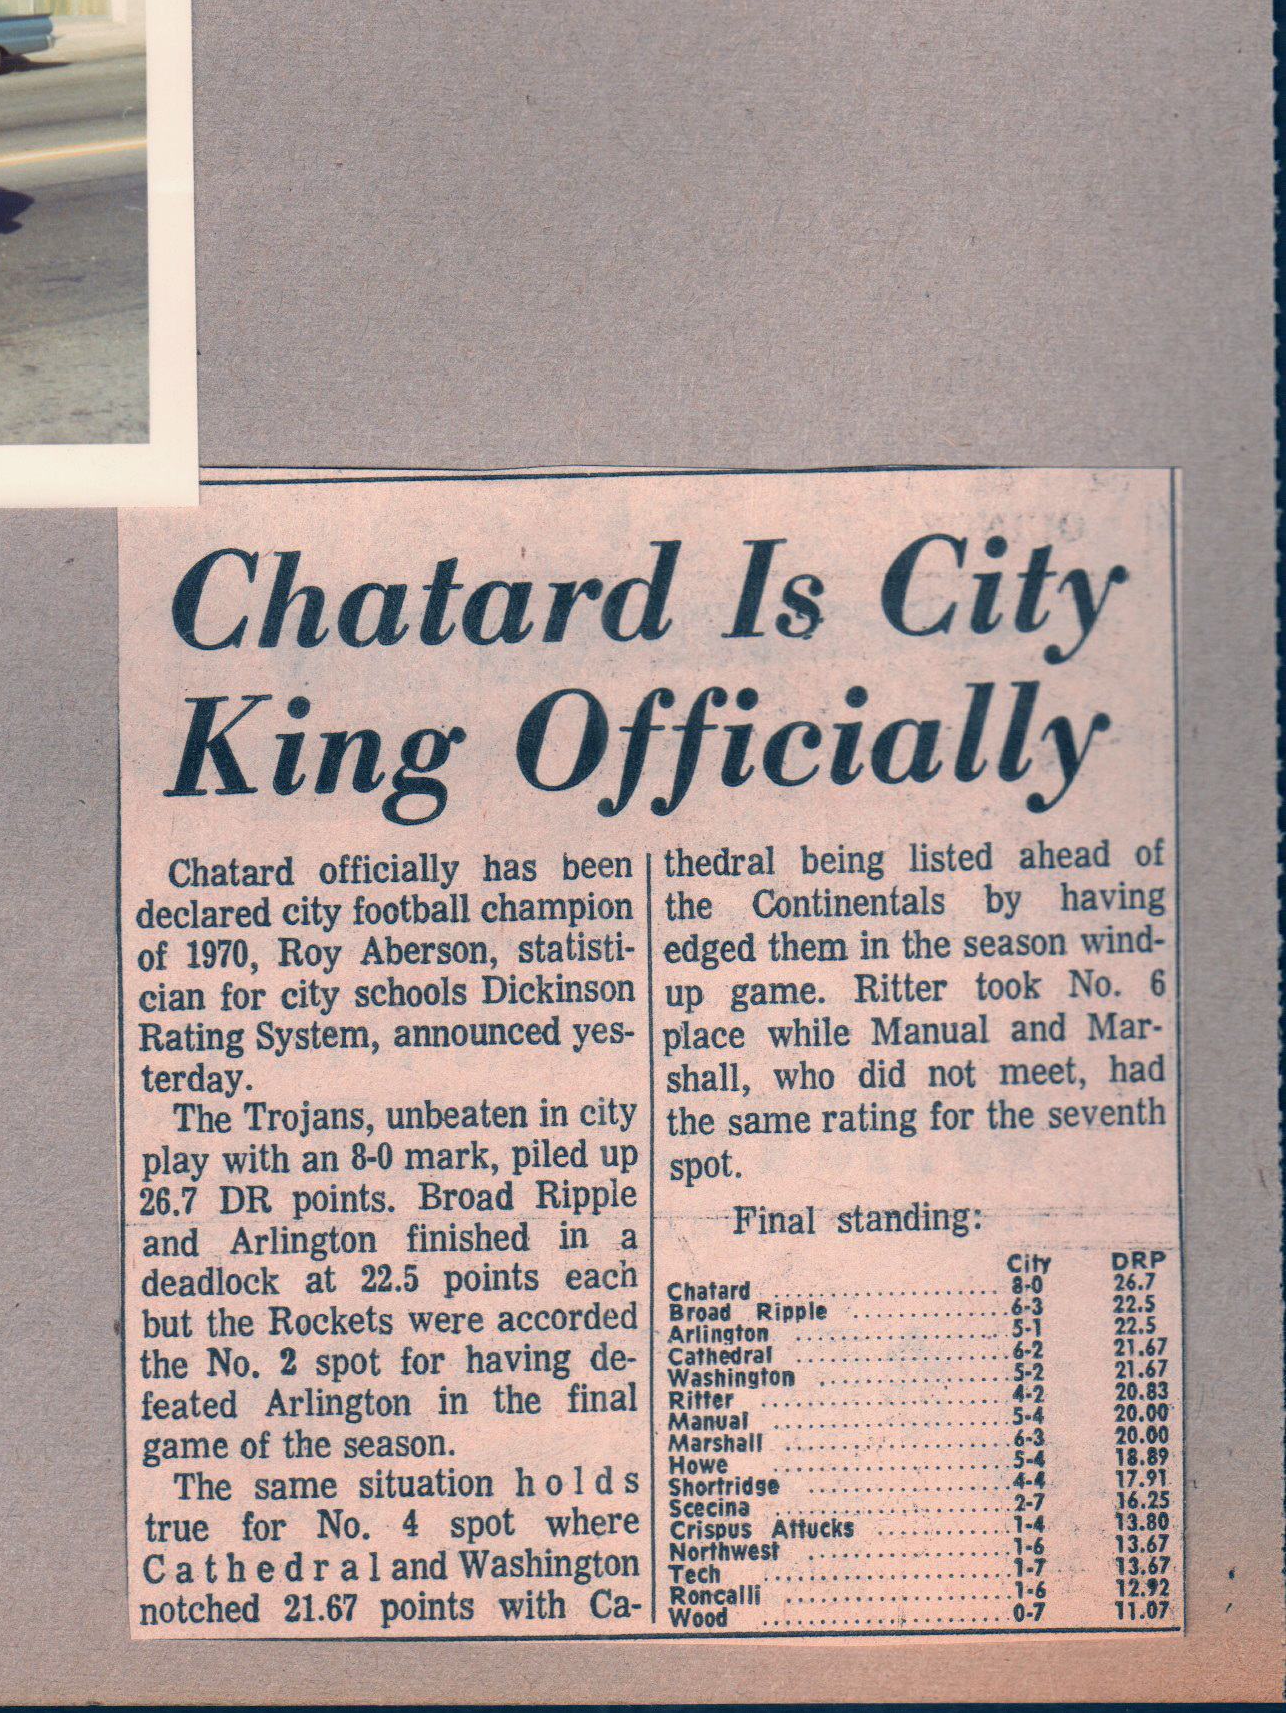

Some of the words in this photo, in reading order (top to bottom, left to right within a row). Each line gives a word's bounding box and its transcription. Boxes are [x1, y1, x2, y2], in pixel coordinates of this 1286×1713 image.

[172, 541, 681, 650] Chatard
[722, 539, 823, 640] Is
[882, 534, 1128, 664] City
[163, 695, 466, 826] King
[517, 681, 1110, 817] Officially
[169, 856, 294, 888] Chatard
[320, 853, 459, 889] officially
[483, 855, 536, 881] has
[563, 853, 632, 880] been
[136, 897, 271, 928] declared
[283, 897, 341, 932] city
[353, 894, 470, 925] football
[481, 893, 633, 927] champion
[138, 941, 168, 972] of
[187, 939, 259, 973] 1970,
[278, 938, 341, 974] Roy
[361, 936, 497, 969] Aberson,
[519, 932, 634, 963] statisti-
[139, 983, 205, 1012] cian
[221, 982, 266, 1011] for
[282, 980, 339, 1015] city
[355, 977, 466, 1007] schools
[482, 975, 635, 1004] Dickinson
[138, 1023, 244, 1058] Rating
[257, 1021, 379, 1057] System,
[394, 1016, 561, 1047] announced
[573, 1023, 634, 1053] yes-
[142, 1063, 252, 1098] terday.
[733, 1206, 815, 1234] Final
[838, 1202, 980, 1237] standing:
[1007, 1254, 1051, 1274] City
[1112, 1251, 1166, 1270] DRP
[668, 1281, 750, 1301] Chatard
[1012, 1275, 1042, 1294] 8-0
[1114, 1273, 1155, 1291] 26.7
[670, 1303, 730, 1322] Broad
[757, 1302, 827, 1323] Ripple
[1012, 1297, 1043, 1315] 6-3
[1113, 1295, 1155, 1313] 22.5
[668, 1325, 768, 1345] Arlington
[1013, 1319, 1040, 1338] 5-1
[1115, 1316, 1156, 1335] 22.5
[668, 1346, 772, 1366] Cathedral
[1013, 1341, 1043, 1359] 6-2
[1114, 1337, 1167, 1356] 21.67
[668, 1368, 794, 1389] Washington
[1014, 1363, 1044, 1381] 5-2
[1115, 1359, 1168, 1379] 21.67
[669, 1391, 733, 1409] Ritter
[1013, 1384, 1044, 1403] 4-2
[1116, 1381, 1168, 1401] 20.83
[669, 1412, 748, 1430] Manual
[1013, 1406, 1044, 1425] 5-4
[1114, 1403, 1169, 1422] 20.00
[669, 1433, 762, 1452] Marshall
[1014, 1428, 1045, 1447] 6-3
[1115, 1425, 1168, 1445] 20.00
[669, 1456, 727, 1475] Howe
[1014, 1450, 1045, 1469] 5-4
[1116, 1447, 1168, 1466] 18.89
[669, 1477, 779, 1496] Shortridge
[1013, 1471, 1045, 1489] 4-4
[1116, 1469, 1166, 1488] 17.91
[670, 1499, 749, 1518] Scecina
[1015, 1493, 1045, 1512] 2-7
[1117, 1491, 1169, 1509] 16.25
